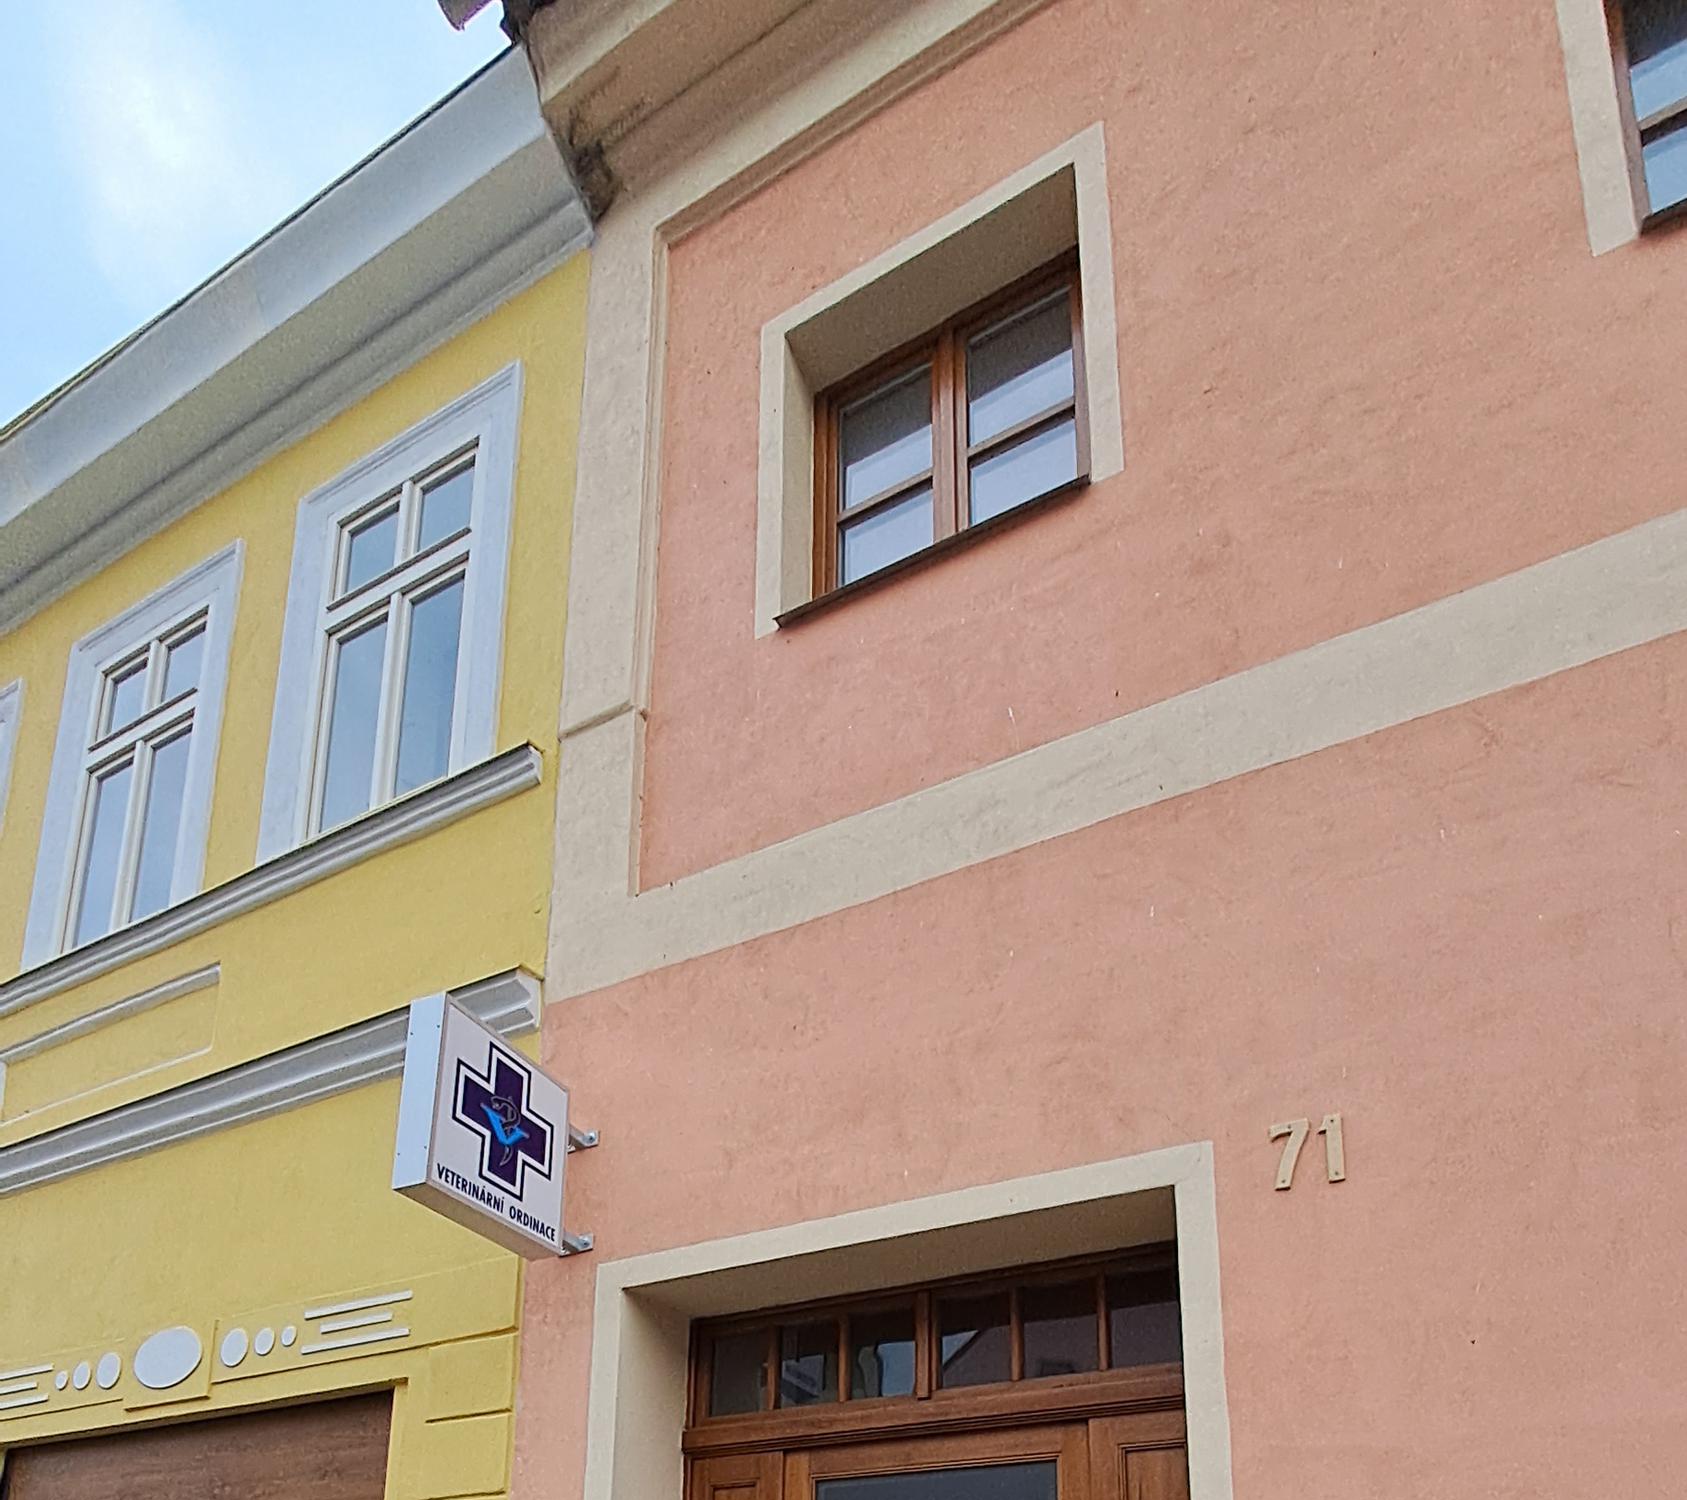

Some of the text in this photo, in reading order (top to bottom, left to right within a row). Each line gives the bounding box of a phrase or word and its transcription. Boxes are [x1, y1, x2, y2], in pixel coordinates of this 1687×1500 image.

[1268, 1113, 1346, 1191] 71
[437, 1163, 556, 1242] VETERINÁRNÍ ORDINACE
